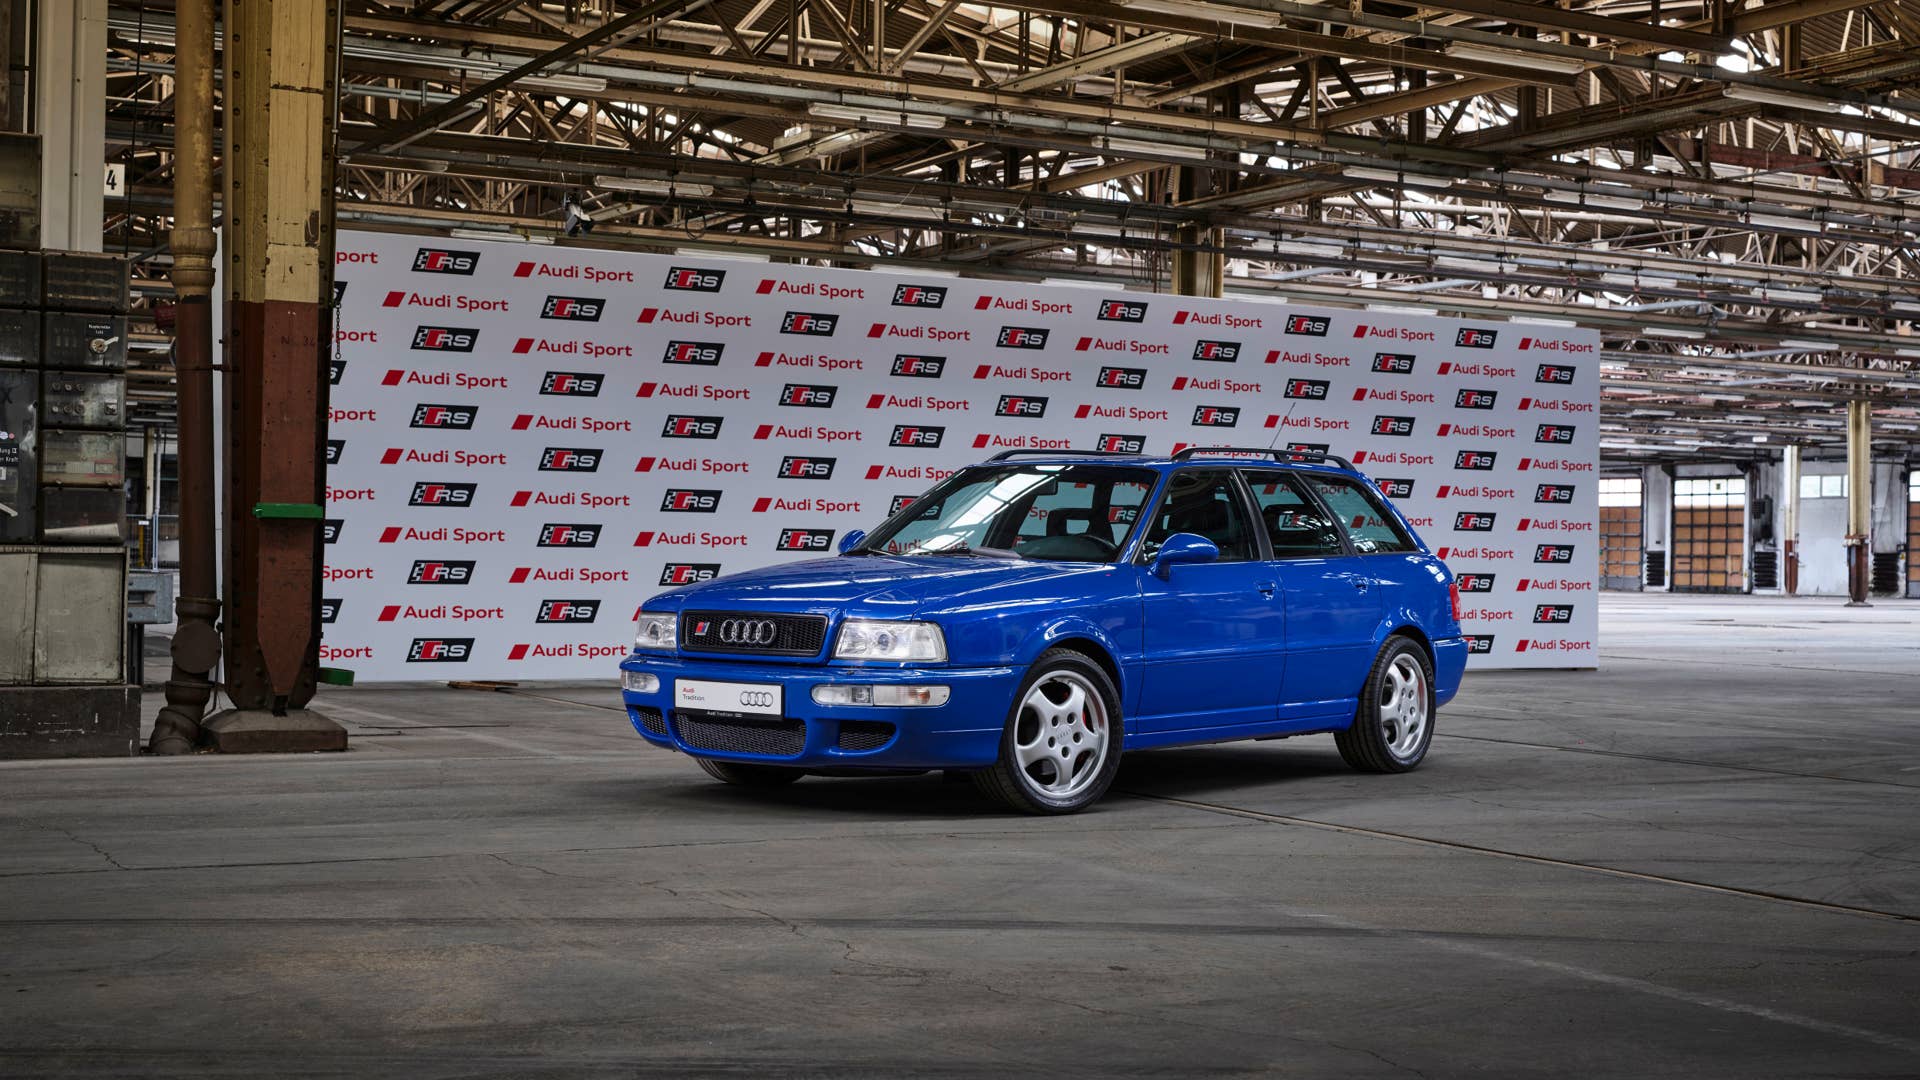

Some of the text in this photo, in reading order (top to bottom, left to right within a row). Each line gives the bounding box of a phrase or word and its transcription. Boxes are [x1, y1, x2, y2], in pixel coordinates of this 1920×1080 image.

[106, 169, 117, 190] 4
[436, 255, 473, 269] RS
[538, 264, 632, 282] Audi Sport
[685, 274, 719, 287] RS
[778, 281, 864, 299] Audi Sport
[408, 292, 507, 312] Audi Sport
[911, 291, 941, 303] RS
[563, 303, 599, 316] RS
[995, 298, 1071, 314] Audi Sport
[661, 309, 751, 328] Audi Sport
[1115, 307, 1142, 318] RS
[800, 319, 832, 331] RS
[1192, 313, 1262, 328] Audi Sport
[1301, 321, 1326, 332] RS
[888, 325, 969, 340] Audi Sport
[1370, 327, 1434, 340] Audi Sport
[435, 333, 472, 346] RS
[1015, 333, 1044, 345] RS
[1470, 334, 1493, 344] RS
[537, 340, 631, 356] Audi Sport
[1095, 339, 1168, 354] Audi Sport
[1534, 339, 1592, 352] Audi Sport
[684, 348, 718, 361] RS
[1209, 347, 1236, 358] RS
[777, 354, 862, 370] Audi Sport
[1283, 352, 1349, 366] Audi Sport
[1387, 359, 1412, 369] RS
[910, 361, 940, 373] RS
[1453, 363, 1515, 376] Audi Sport
[408, 371, 507, 389] Audi Sport
[993, 367, 1070, 382] Audi Sport
[1114, 374, 1142, 385] RS
[1549, 370, 1572, 380] RS
[562, 379, 597, 391] RS
[1190, 378, 1260, 393] Audi Sport
[1300, 385, 1325, 395] RS
[660, 384, 749, 400] Audi Sport
[799, 391, 831, 403] RS
[1370, 390, 1434, 403] Audi Sport
[888, 396, 968, 410] Audi Sport
[1469, 395, 1493, 405] RS
[1534, 400, 1592, 412] Audi Sport
[1014, 402, 1043, 413] RS
[1093, 406, 1168, 420] Audi Sport
[433, 411, 470, 424] RS
[1208, 412, 1235, 423] RS
[1282, 416, 1348, 430] Audi Sport
[536, 416, 630, 432] Audi Sport
[683, 422, 717, 434] RS
[1386, 421, 1411, 432] RS
[776, 426, 861, 441] Audi Sport
[908, 432, 939, 443] RS
[1454, 425, 1515, 438] Audi Sport
[1548, 430, 1571, 440] RS
[993, 435, 1070, 449] Audi Sport
[1113, 441, 1141, 452] RS
[407, 450, 505, 465] Audi Sport
[561, 454, 596, 467] RS
[1369, 452, 1433, 465] Audi Sport
[1468, 456, 1492, 466] RS
[658, 458, 748, 474] Audi Sport
[798, 463, 830, 475] RS
[1533, 459, 1592, 471] Audi Sport
[886, 466, 920, 478] Audi
[432, 489, 469, 501] RS
[1386, 484, 1410, 494] RS
[1452, 486, 1514, 499] Audi Sport
[1548, 490, 1570, 499] RS
[536, 492, 629, 508] Audi Sport
[682, 496, 716, 508] RS
[774, 499, 860, 512] Audi Sport
[1409, 517, 1432, 528] port
[1468, 517, 1491, 527] RS
[1533, 520, 1591, 531] Audi Sport
[405, 528, 504, 544] Audi Sport
[560, 530, 595, 542] RS
[657, 532, 746, 548] Audi Sport
[797, 535, 829, 546] RS
[1452, 547, 1513, 560] Audi Sport
[1547, 550, 1570, 559] RS
[431, 567, 468, 579] RS
[534, 568, 628, 584] Audi Sport
[681, 570, 714, 581] RS
[1467, 579, 1490, 589] RS
[1532, 579, 1591, 591] Audi Sport
[405, 605, 503, 621] Audi Sport
[559, 606, 594, 618] RS
[1460, 608, 1512, 621] udi Sport
[1546, 610, 1569, 619] RS
[430, 645, 467, 657] RS
[1466, 640, 1489, 650] RS
[1531, 640, 1590, 650] Audi Sport
[532, 644, 626, 659] Audi Sport
[683, 693, 704, 701] Tradition
